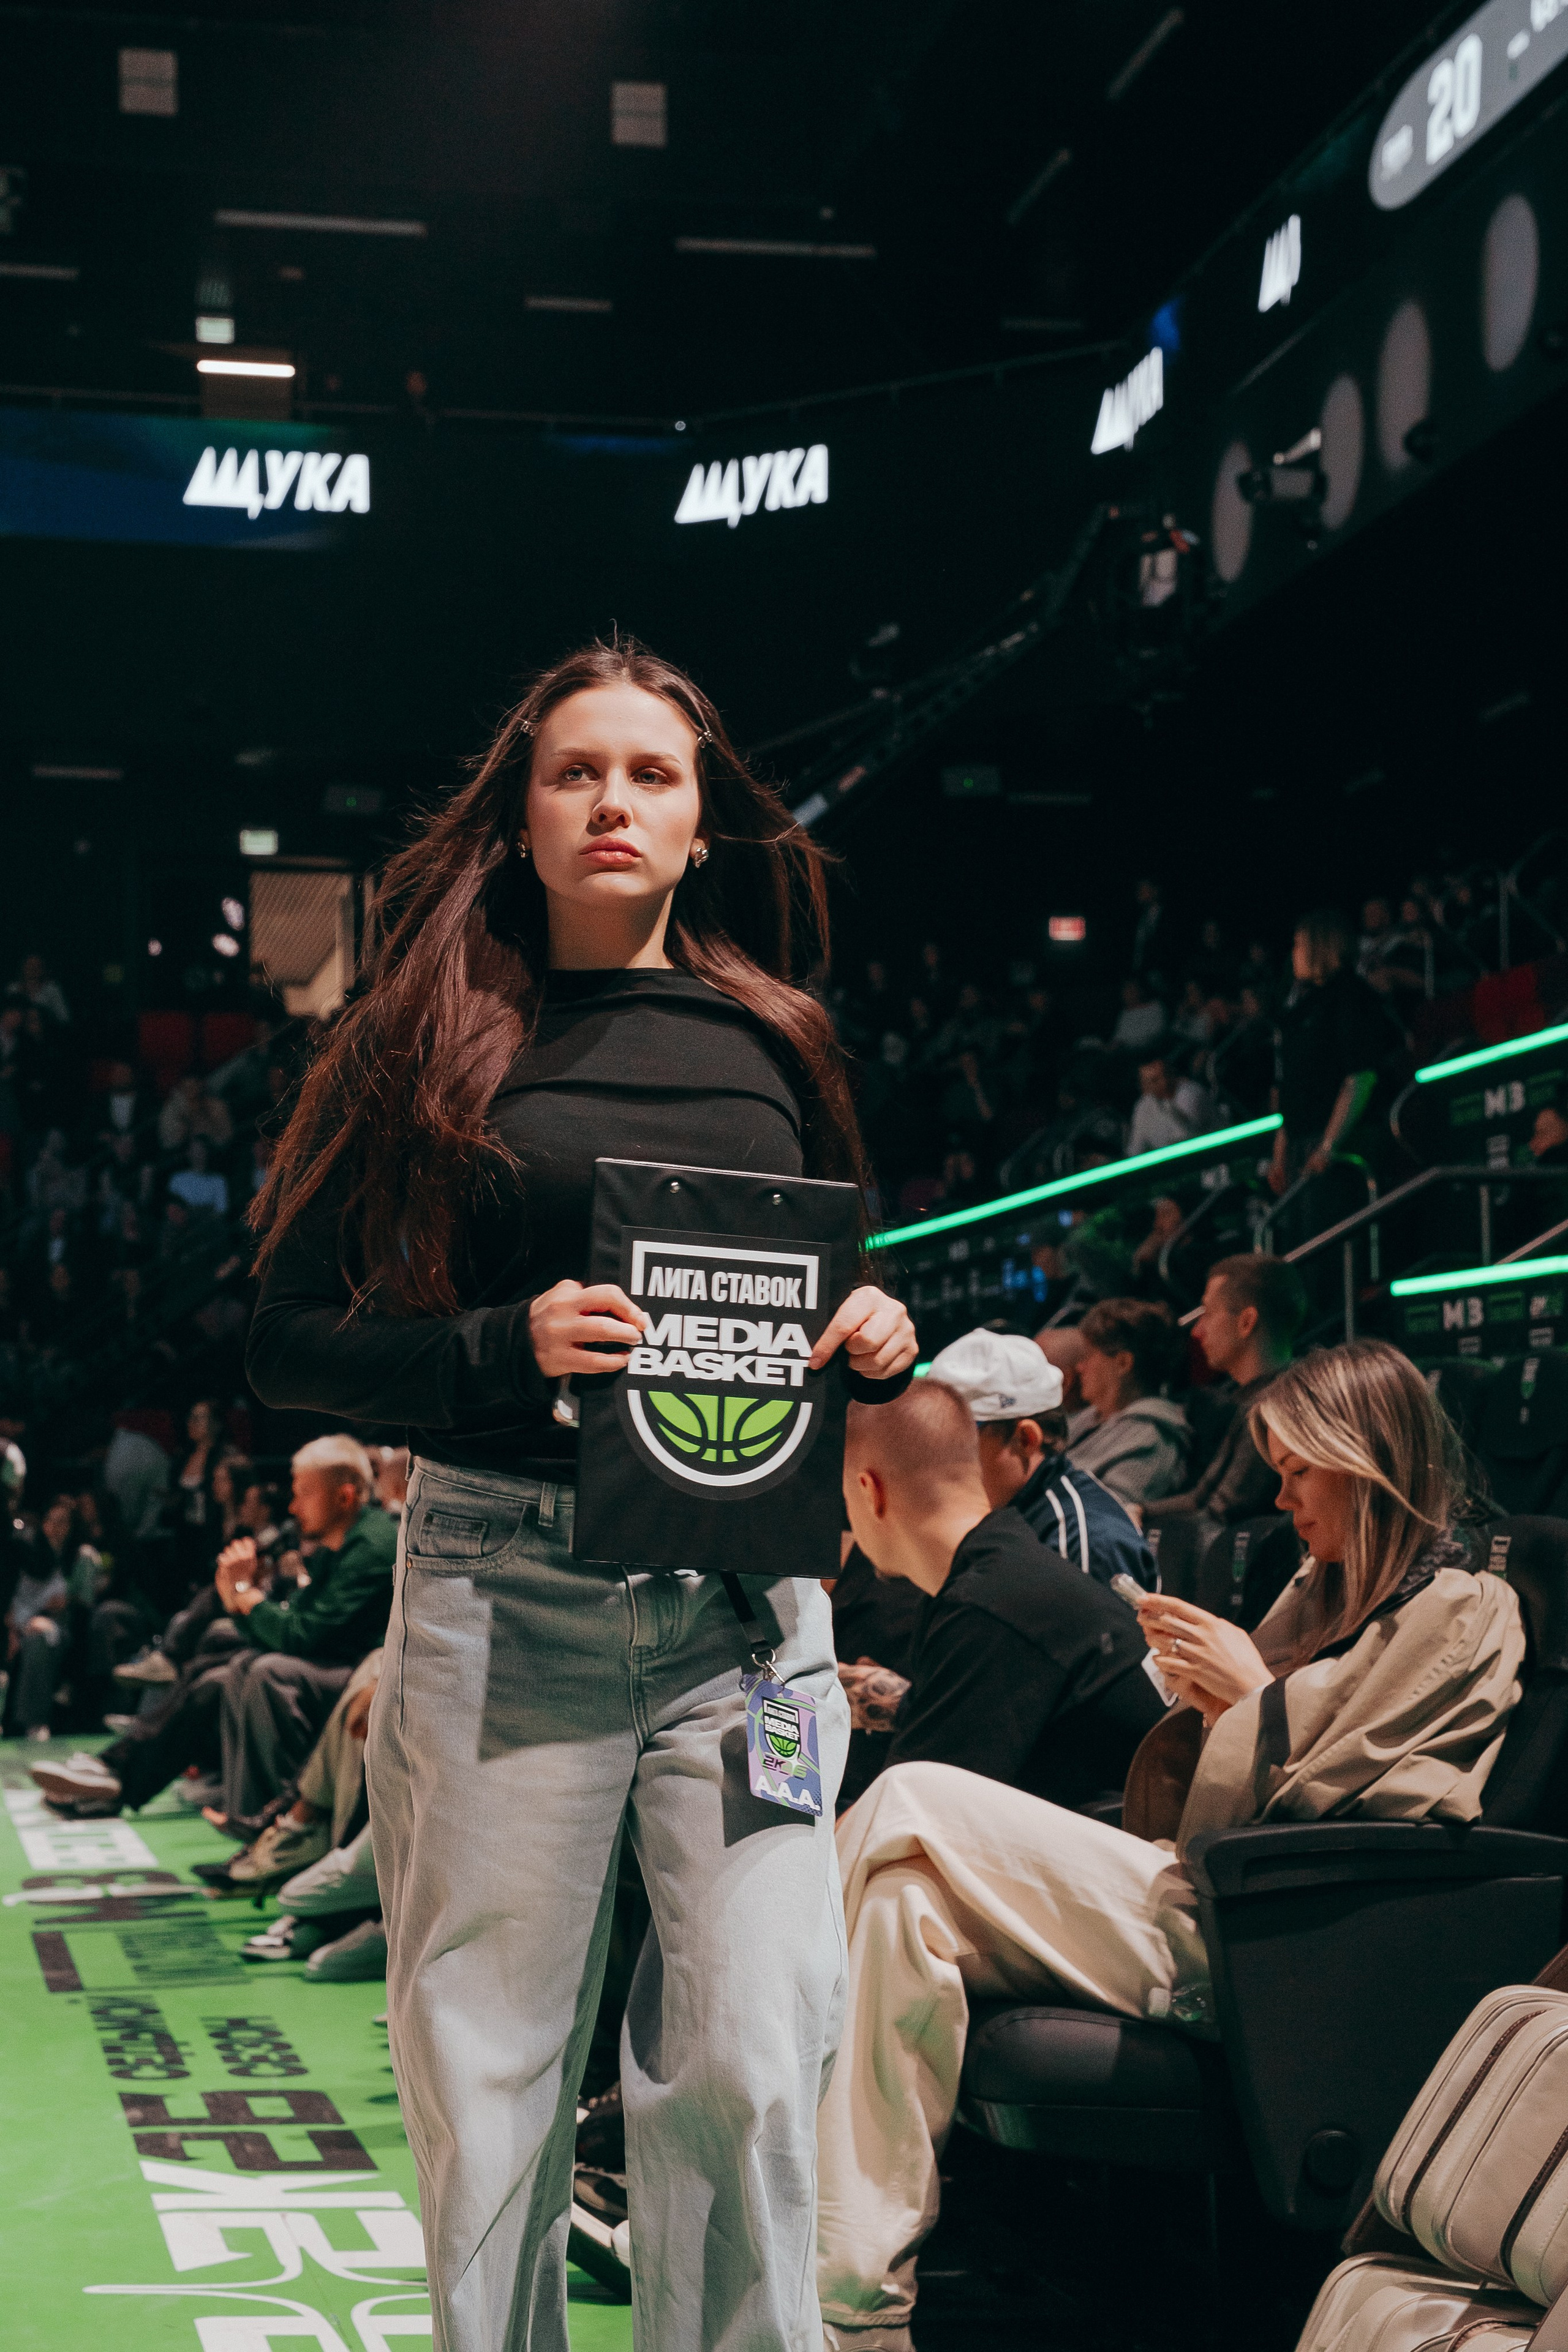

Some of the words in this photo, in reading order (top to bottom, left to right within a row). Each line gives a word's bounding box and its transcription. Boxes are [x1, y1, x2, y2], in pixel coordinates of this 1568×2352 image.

[1427, 34, 1482, 164] 20
[183, 446, 371, 519] ЩУКА
[674, 428, 829, 527] ЩУКА
[647, 1266, 707, 1301] ЛИГА
[711, 1271, 802, 1309] СТАВОК
[637, 1312, 812, 1357] MEDIA
[628, 1348, 810, 1387] BASKET
[764, 1716, 799, 1734] MEDIA
[764, 1724, 800, 1741] BASKET
